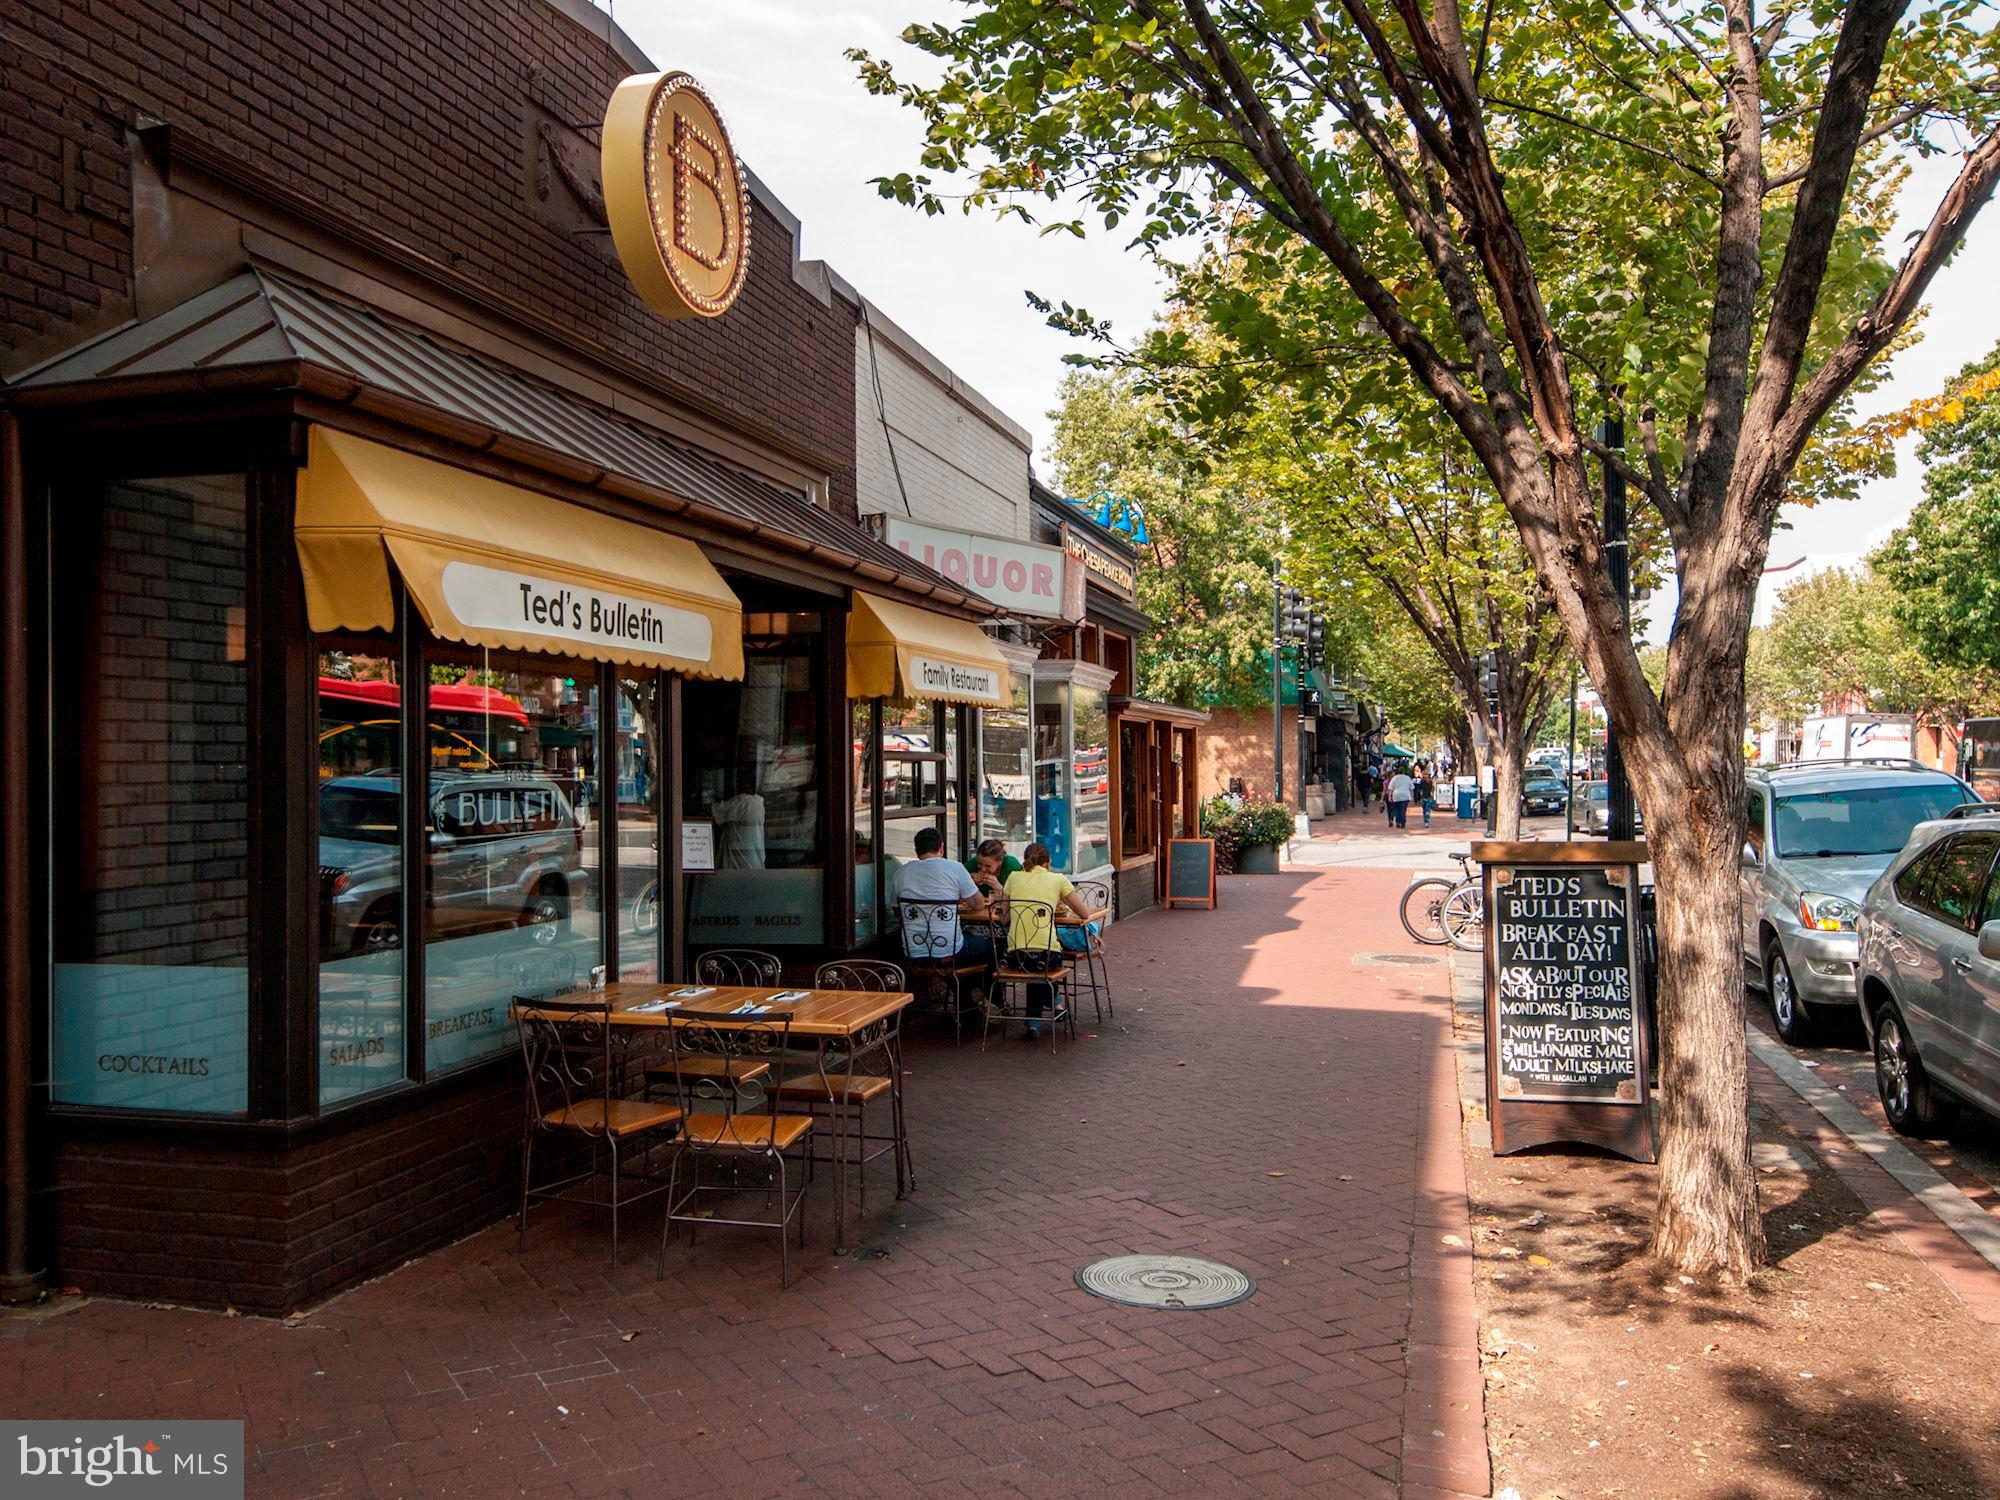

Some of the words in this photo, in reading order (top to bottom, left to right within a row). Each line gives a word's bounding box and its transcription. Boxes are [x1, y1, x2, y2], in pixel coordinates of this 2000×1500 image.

[1081, 544, 1120, 584] CHESAPEAKE
[519, 583, 582, 630] Ted's
[590, 597, 663, 644] Bulletin
[923, 662, 950, 689] Family
[951, 668, 990, 694] Restaurant
[458, 789, 574, 827] BULLETIN
[1515, 877, 1580, 896] TED'S
[1510, 899, 1625, 918] BULLETIN
[754, 915, 801, 927] BAGELS
[1511, 942, 1556, 960] ALL
[1566, 943, 1611, 961] DAY!
[1500, 967, 1534, 985] ASK
[1534, 965, 1587, 985] ABOUT
[1589, 967, 1629, 986] OUR
[1500, 983, 1563, 1001] NIGHTLY
[1564, 983, 1630, 1001] SPECIALS
[428, 1008, 495, 1040] BREAKFAST
[328, 1036, 385, 1067] SALADS
[1595, 1045, 1633, 1059] MALT
[97, 1053, 209, 1077] COCKTAILS
[1508, 1058, 1553, 1072] ADULT
[1554, 1059, 1635, 1075] MILKSHAKE
[1552, 1073, 1588, 1082] MACALLAN
